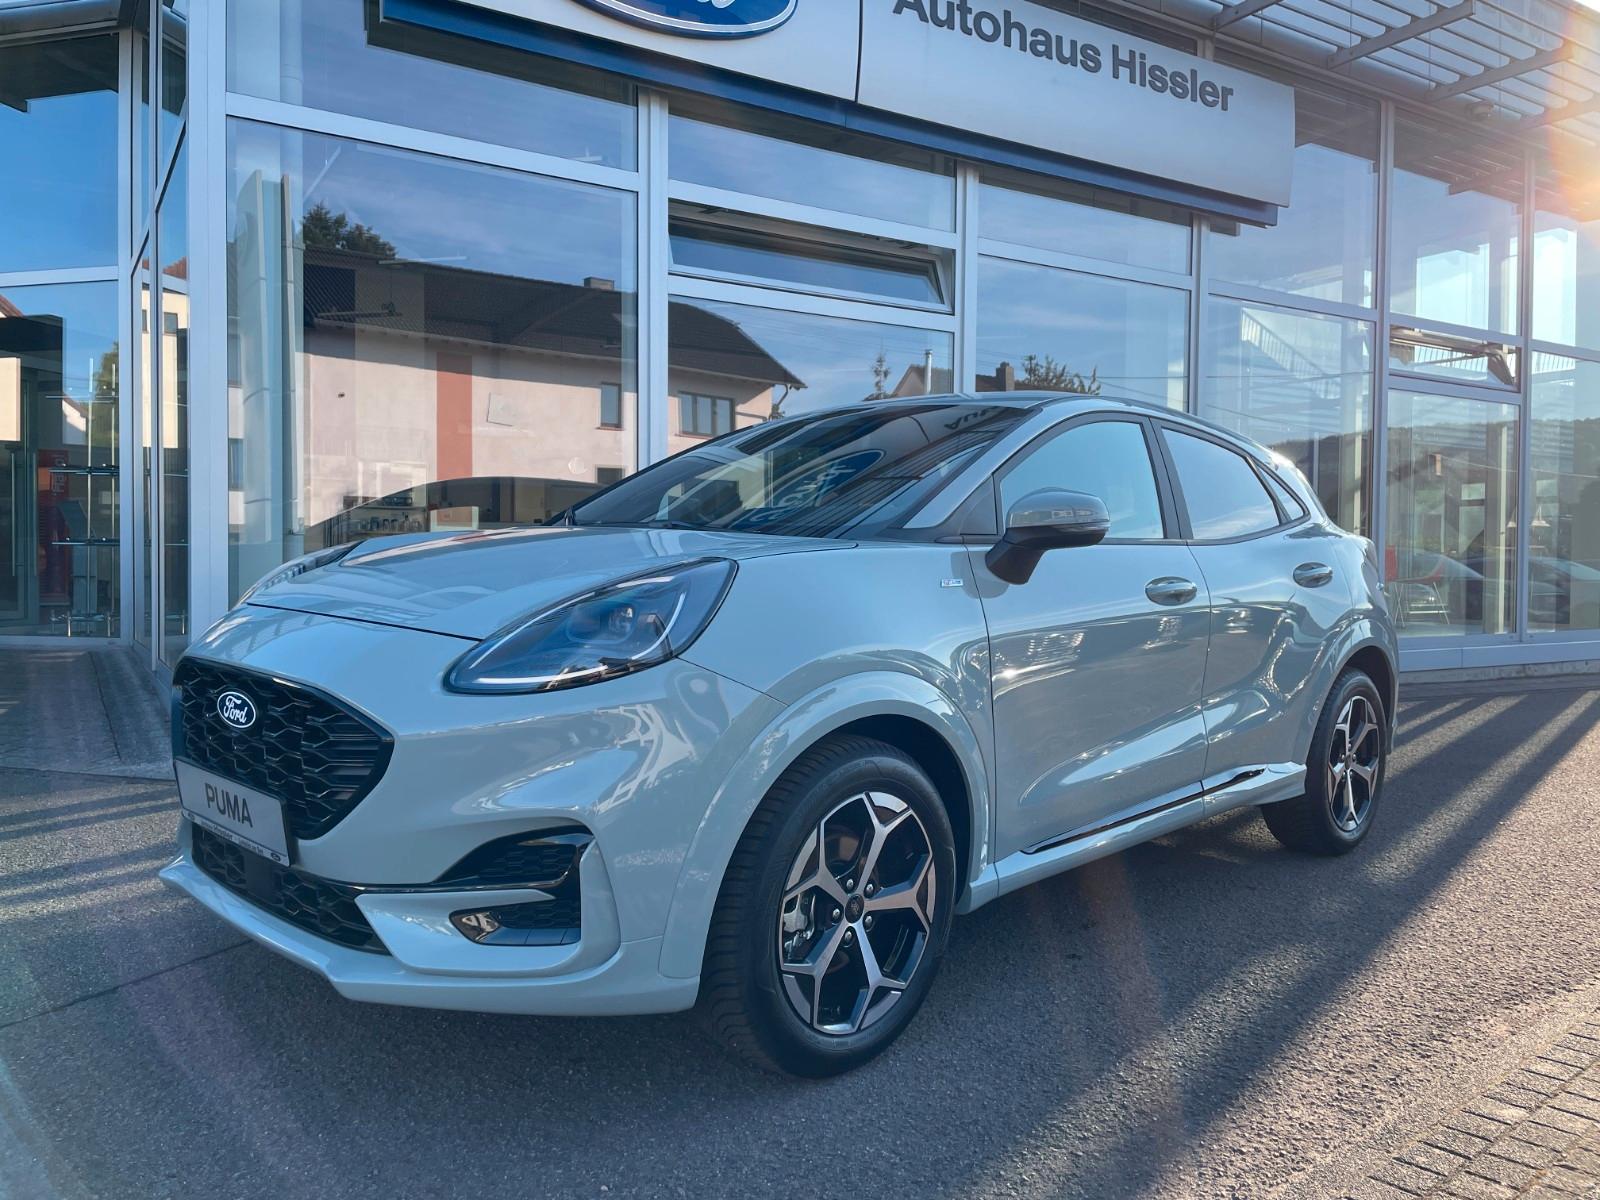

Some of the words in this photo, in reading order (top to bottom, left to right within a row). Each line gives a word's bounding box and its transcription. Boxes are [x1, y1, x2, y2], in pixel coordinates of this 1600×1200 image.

[893, 0, 1102, 73] Autohaus
[1112, 44, 1234, 112] Hissler
[223, 695, 248, 724] Ford
[204, 783, 253, 828] PUMA
